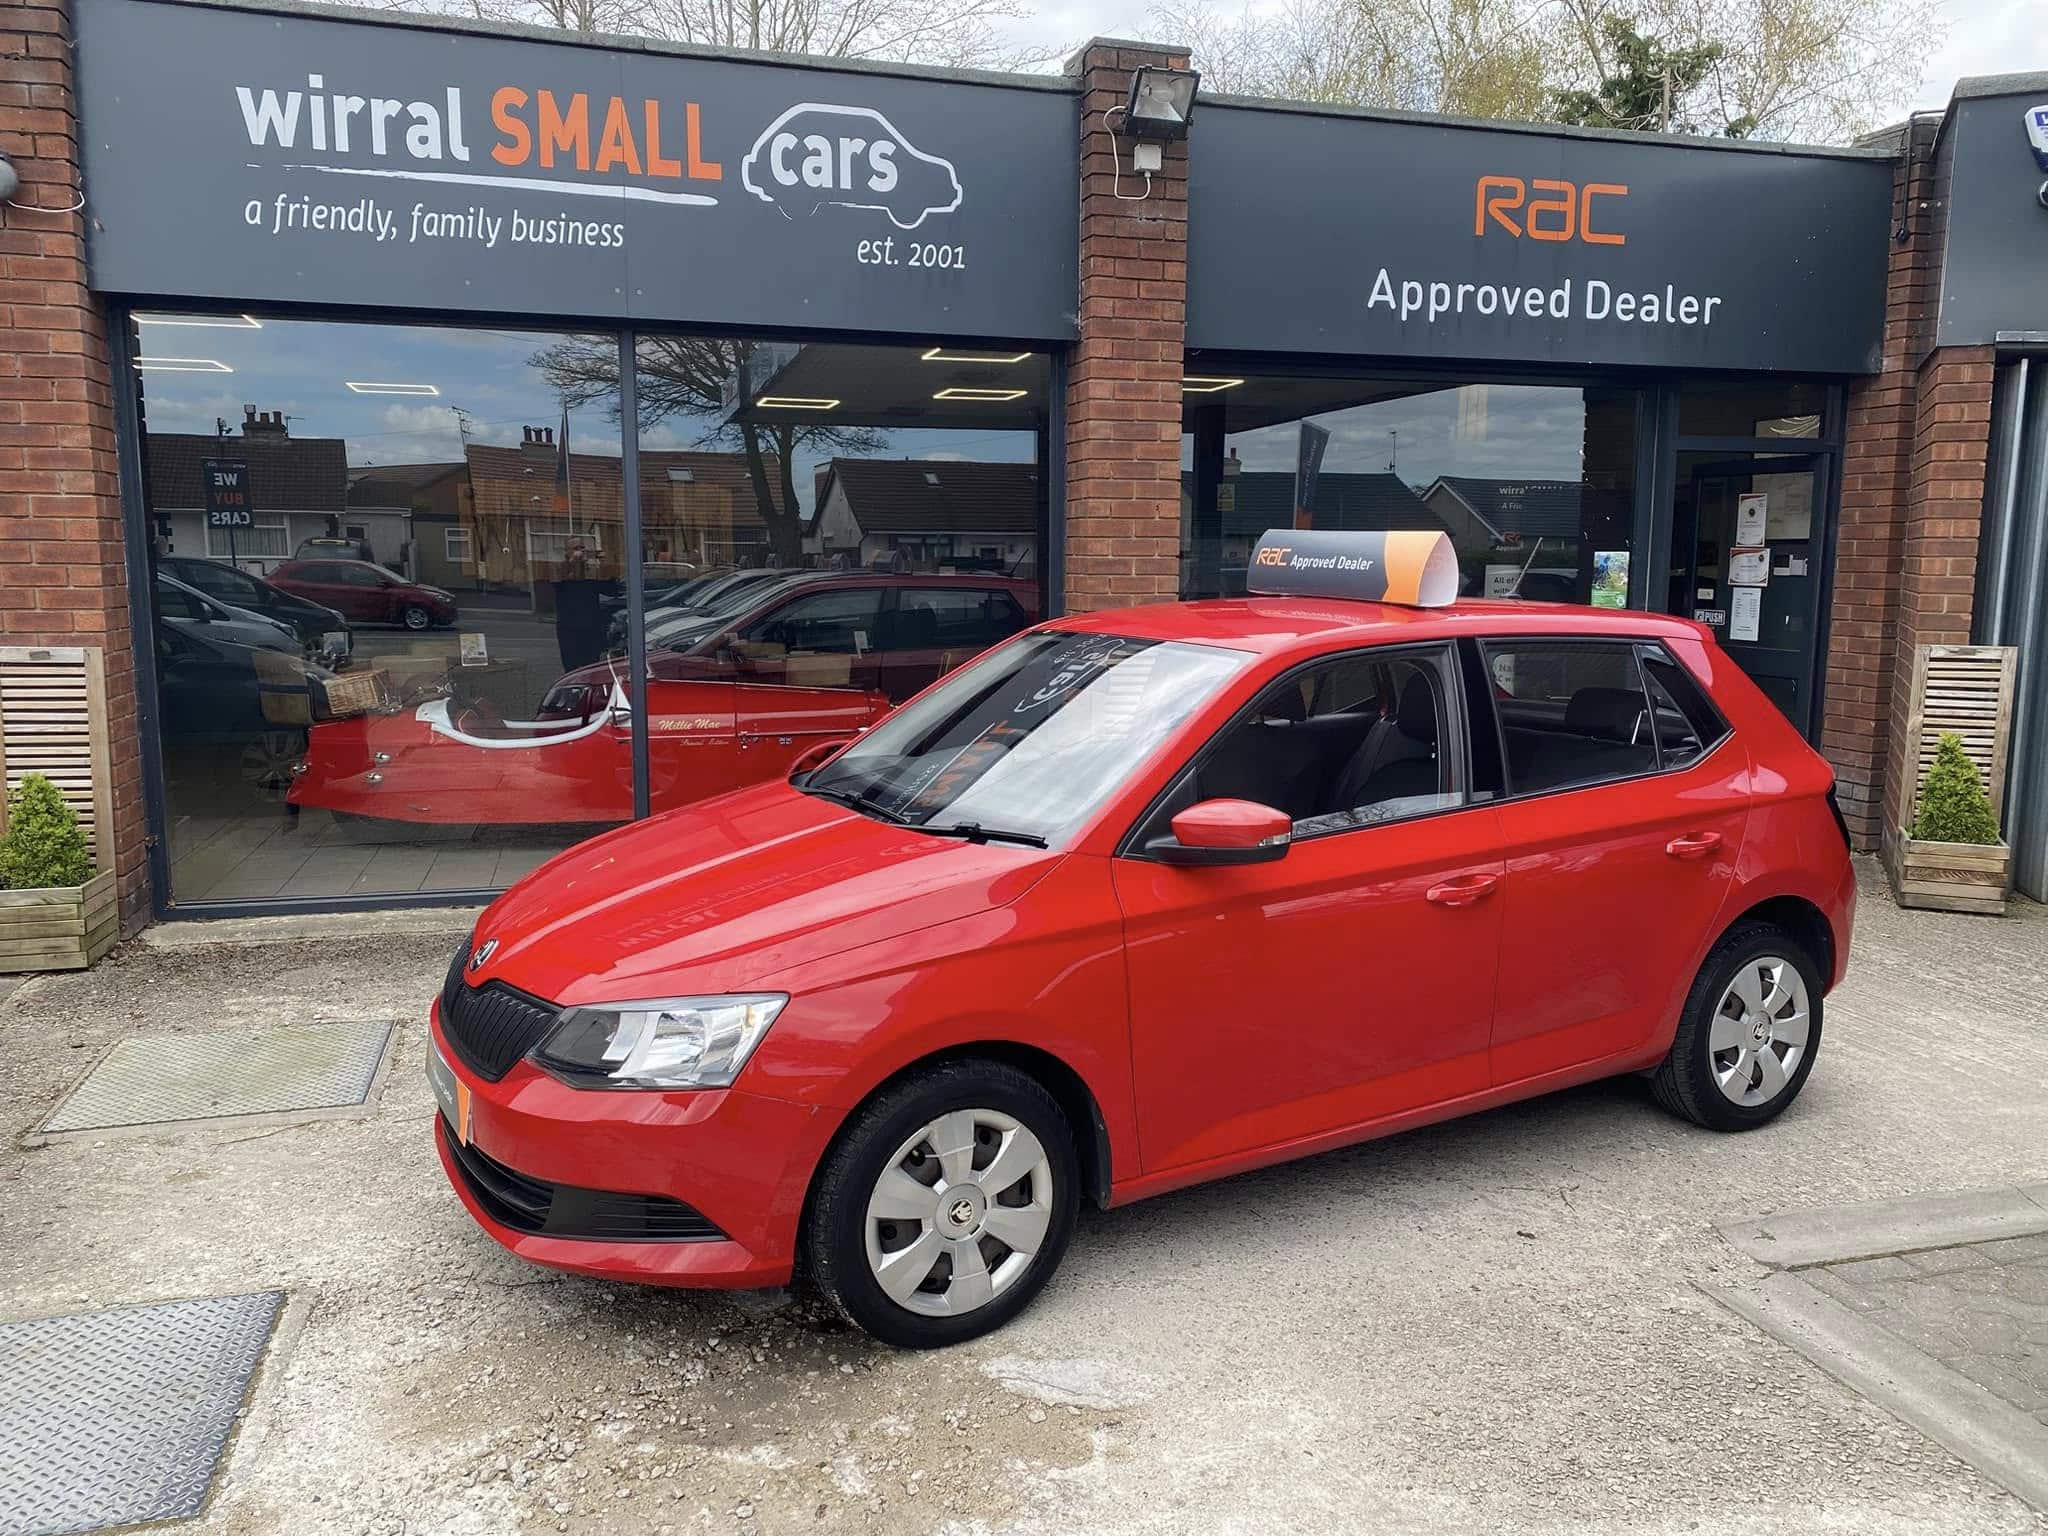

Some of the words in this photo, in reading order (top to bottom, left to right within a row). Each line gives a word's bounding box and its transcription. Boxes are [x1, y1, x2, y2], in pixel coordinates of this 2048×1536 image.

[235, 74, 470, 161] wirral
[491, 86, 722, 180] SMALL
[769, 131, 899, 194] cars
[244, 199, 262, 225] a
[272, 193, 398, 242] friendly,
[408, 202, 503, 248] family
[510, 209, 625, 248] business
[857, 236, 899, 266] est.
[908, 243, 966, 269] 2001
[1367, 268, 1571, 323] Approved
[1585, 280, 1722, 325] Dealer
[1500, 486, 1527, 494] wirra
[1290, 554, 1336, 570] Approved
[1337, 557, 1373, 571] Dealer
[1704, 610, 1723, 623] PUSH
